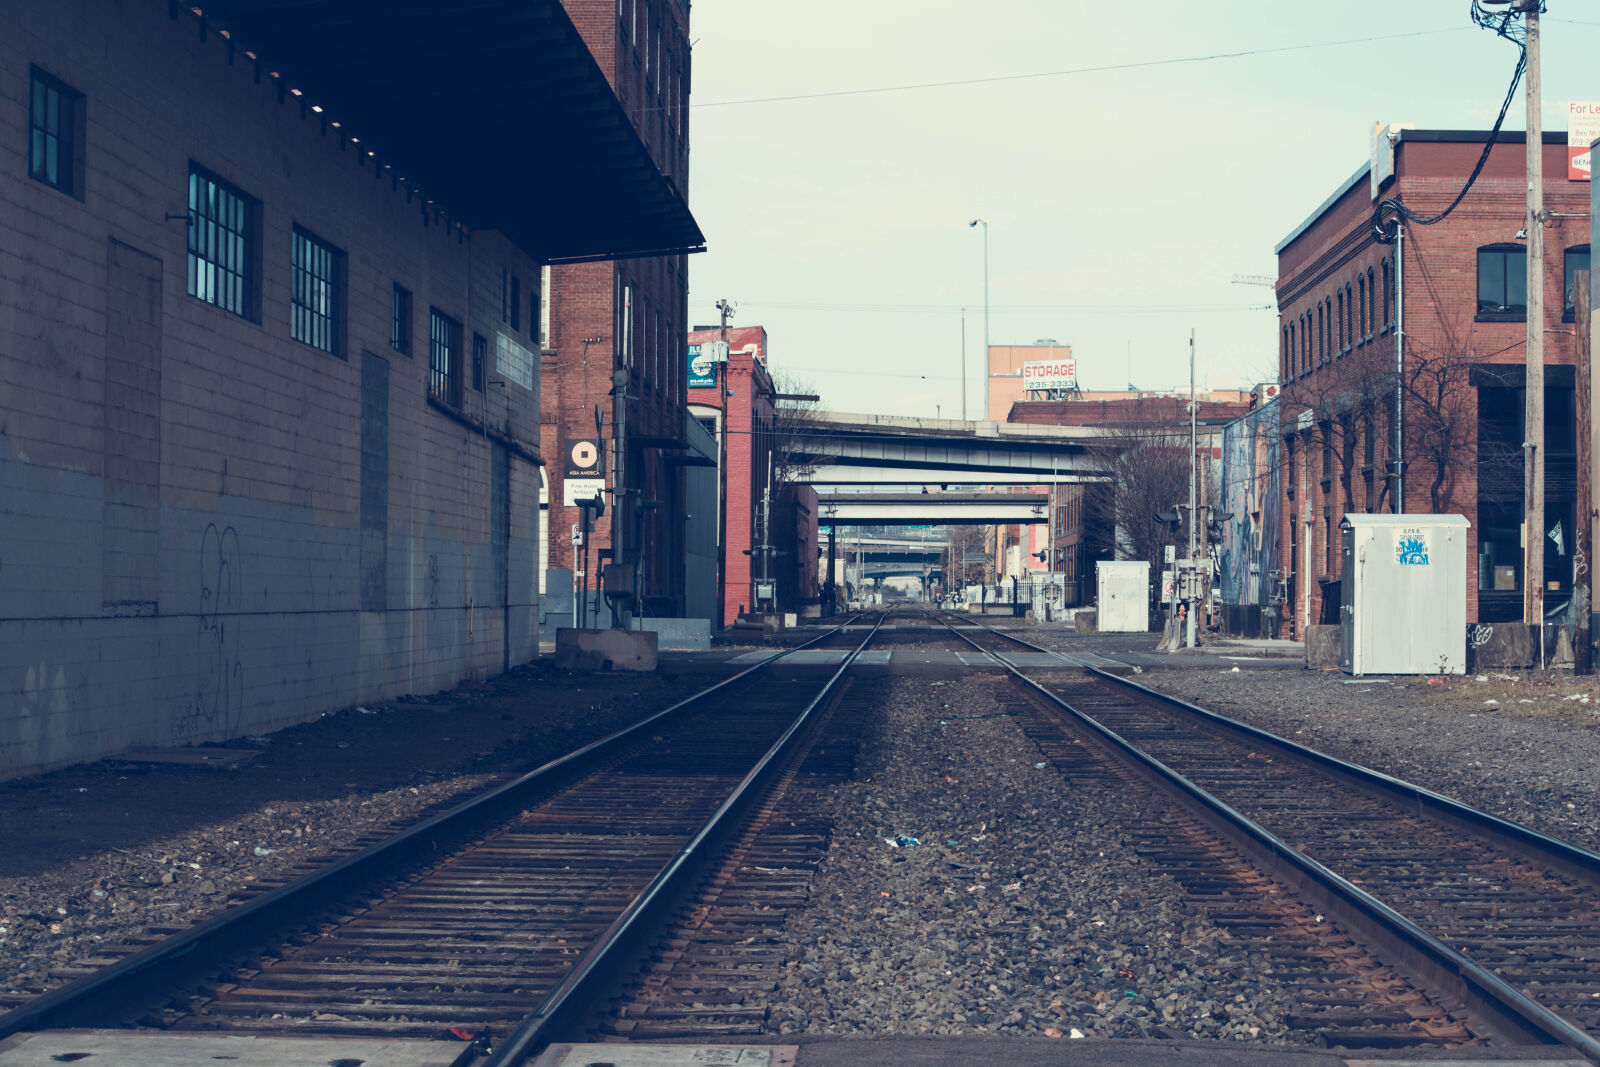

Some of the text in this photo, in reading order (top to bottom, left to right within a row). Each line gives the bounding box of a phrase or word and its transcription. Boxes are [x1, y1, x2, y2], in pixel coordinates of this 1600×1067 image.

[1570, 103, 1587, 114] For
[1024, 364, 1074, 378] STORAGE
[1029, 380, 1074, 389] 235-3333
